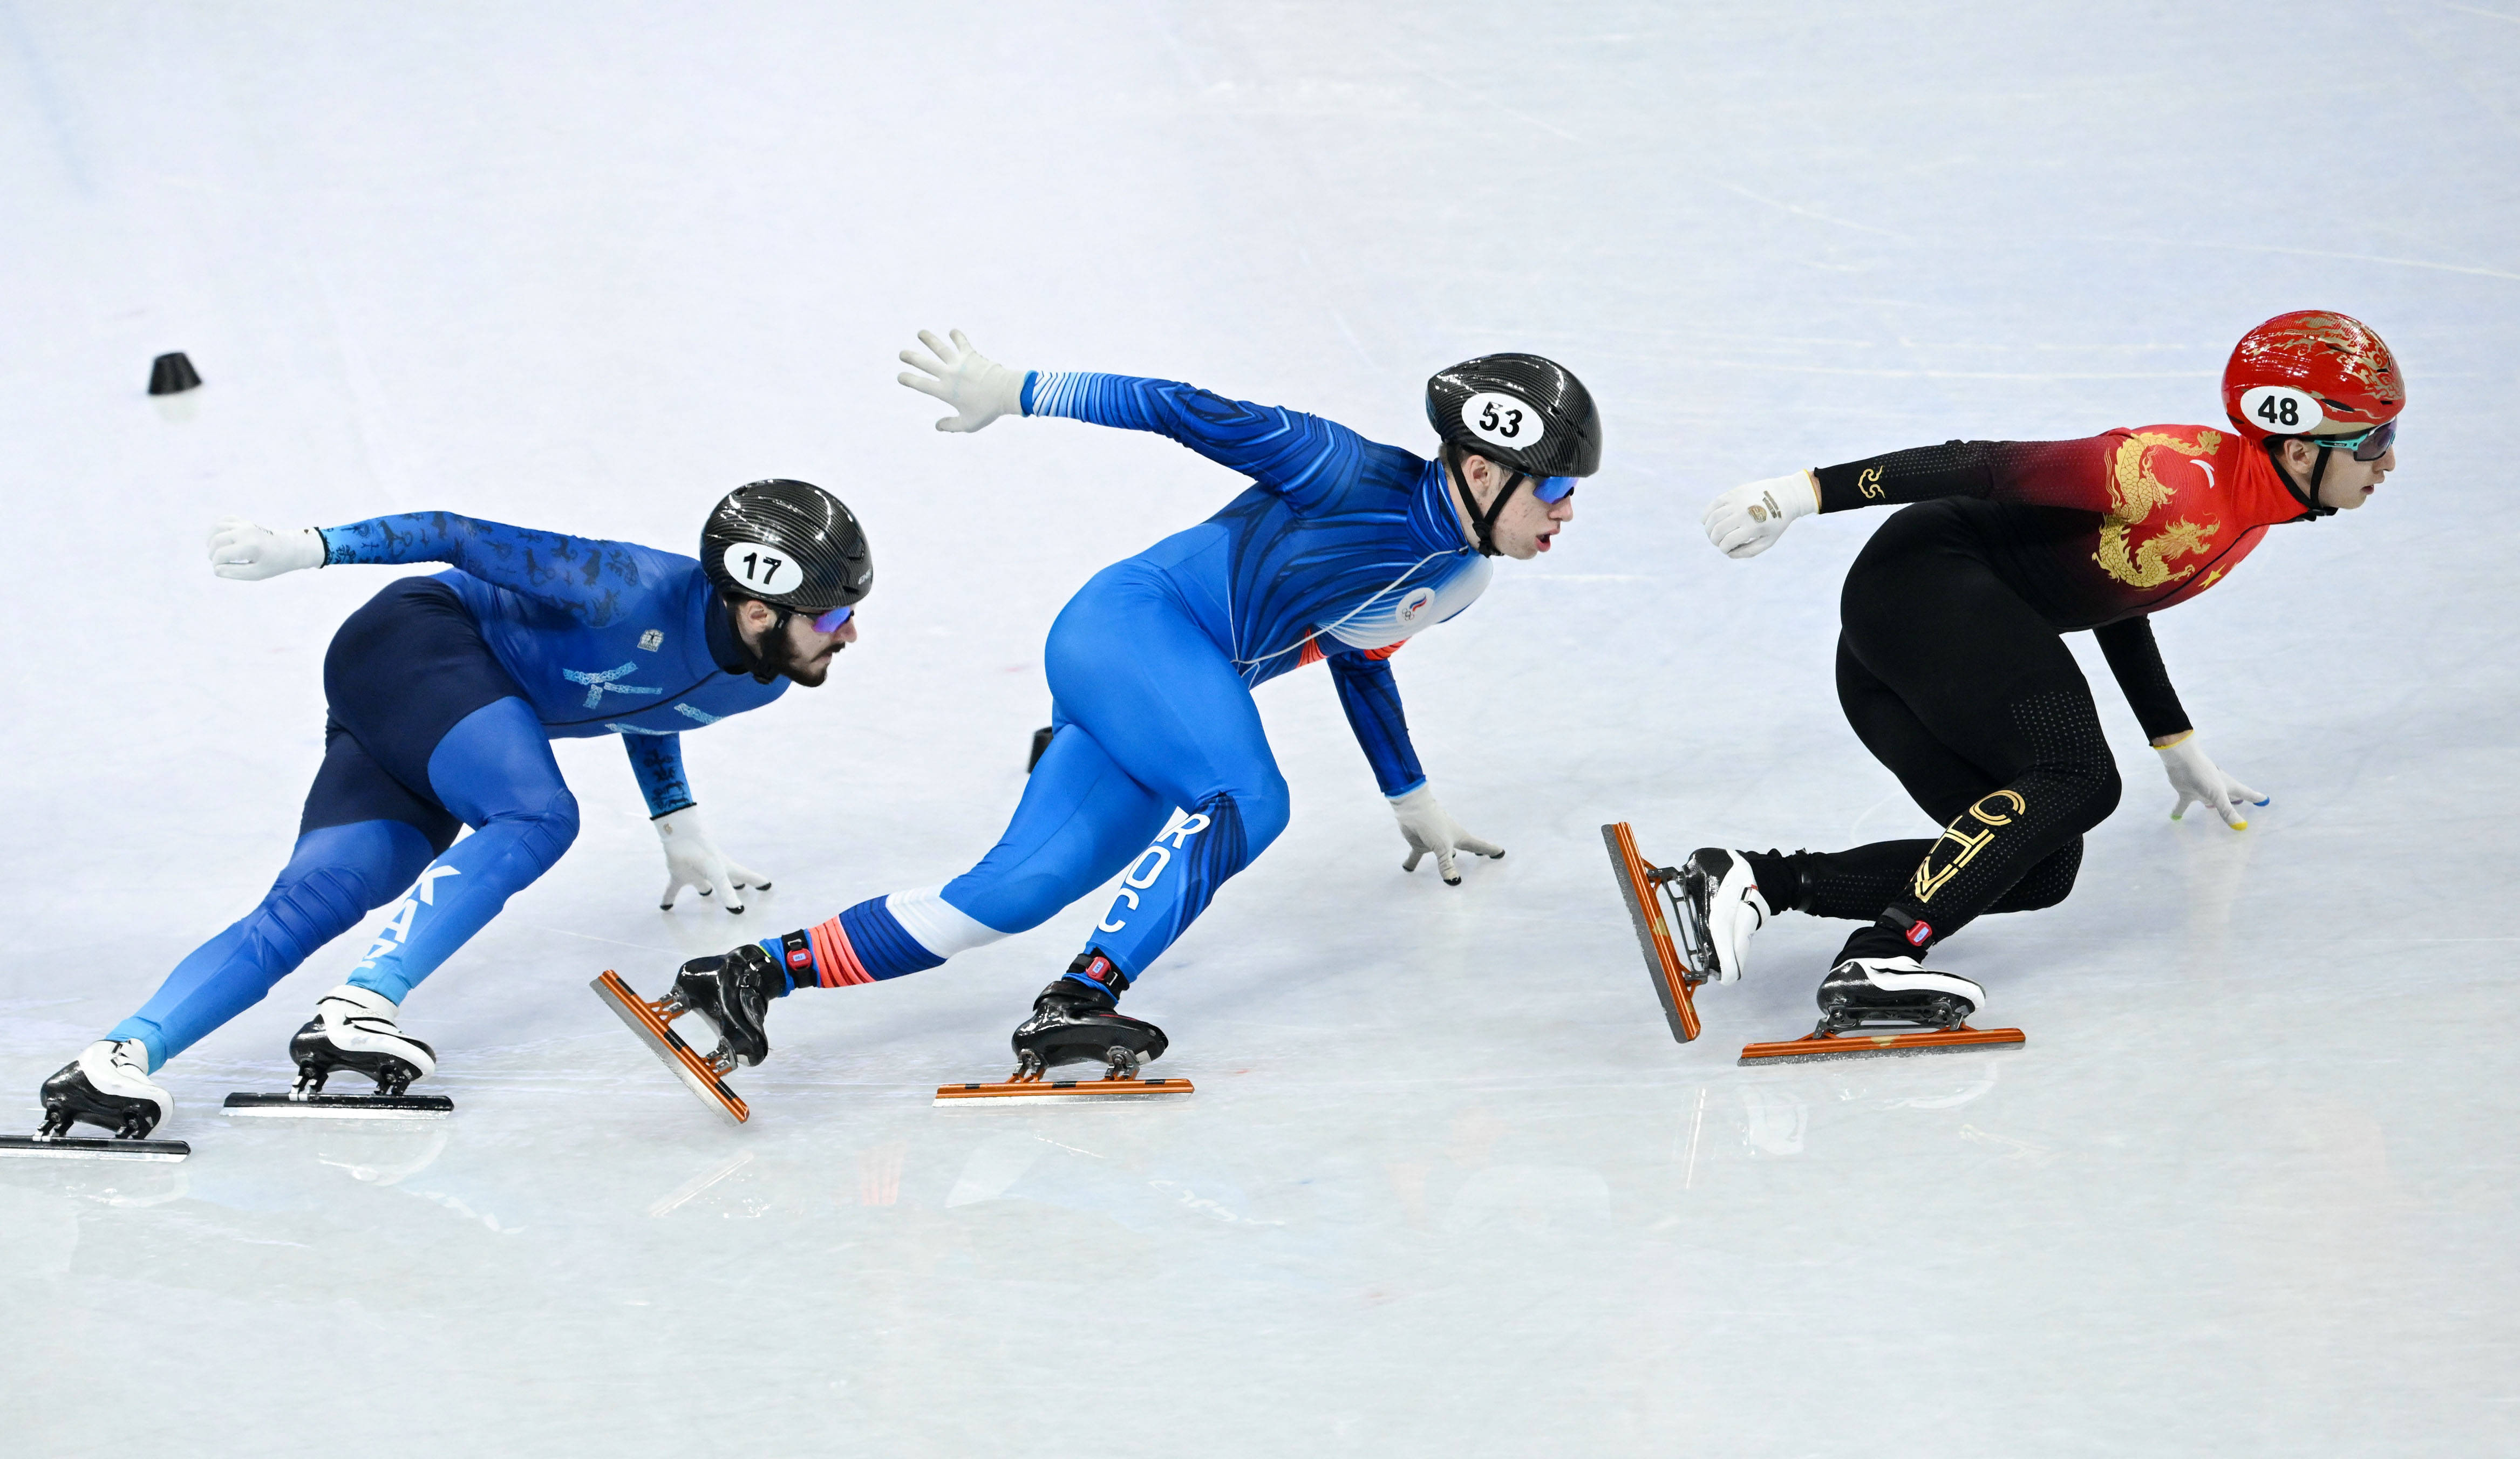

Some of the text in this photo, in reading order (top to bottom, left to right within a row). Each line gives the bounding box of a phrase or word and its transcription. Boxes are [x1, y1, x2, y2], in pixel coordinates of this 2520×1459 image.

[1479, 401, 1523, 438] 53
[2258, 395, 2299, 426] 48
[743, 551, 782, 585] 17
[1098, 813, 1211, 933] ROC
